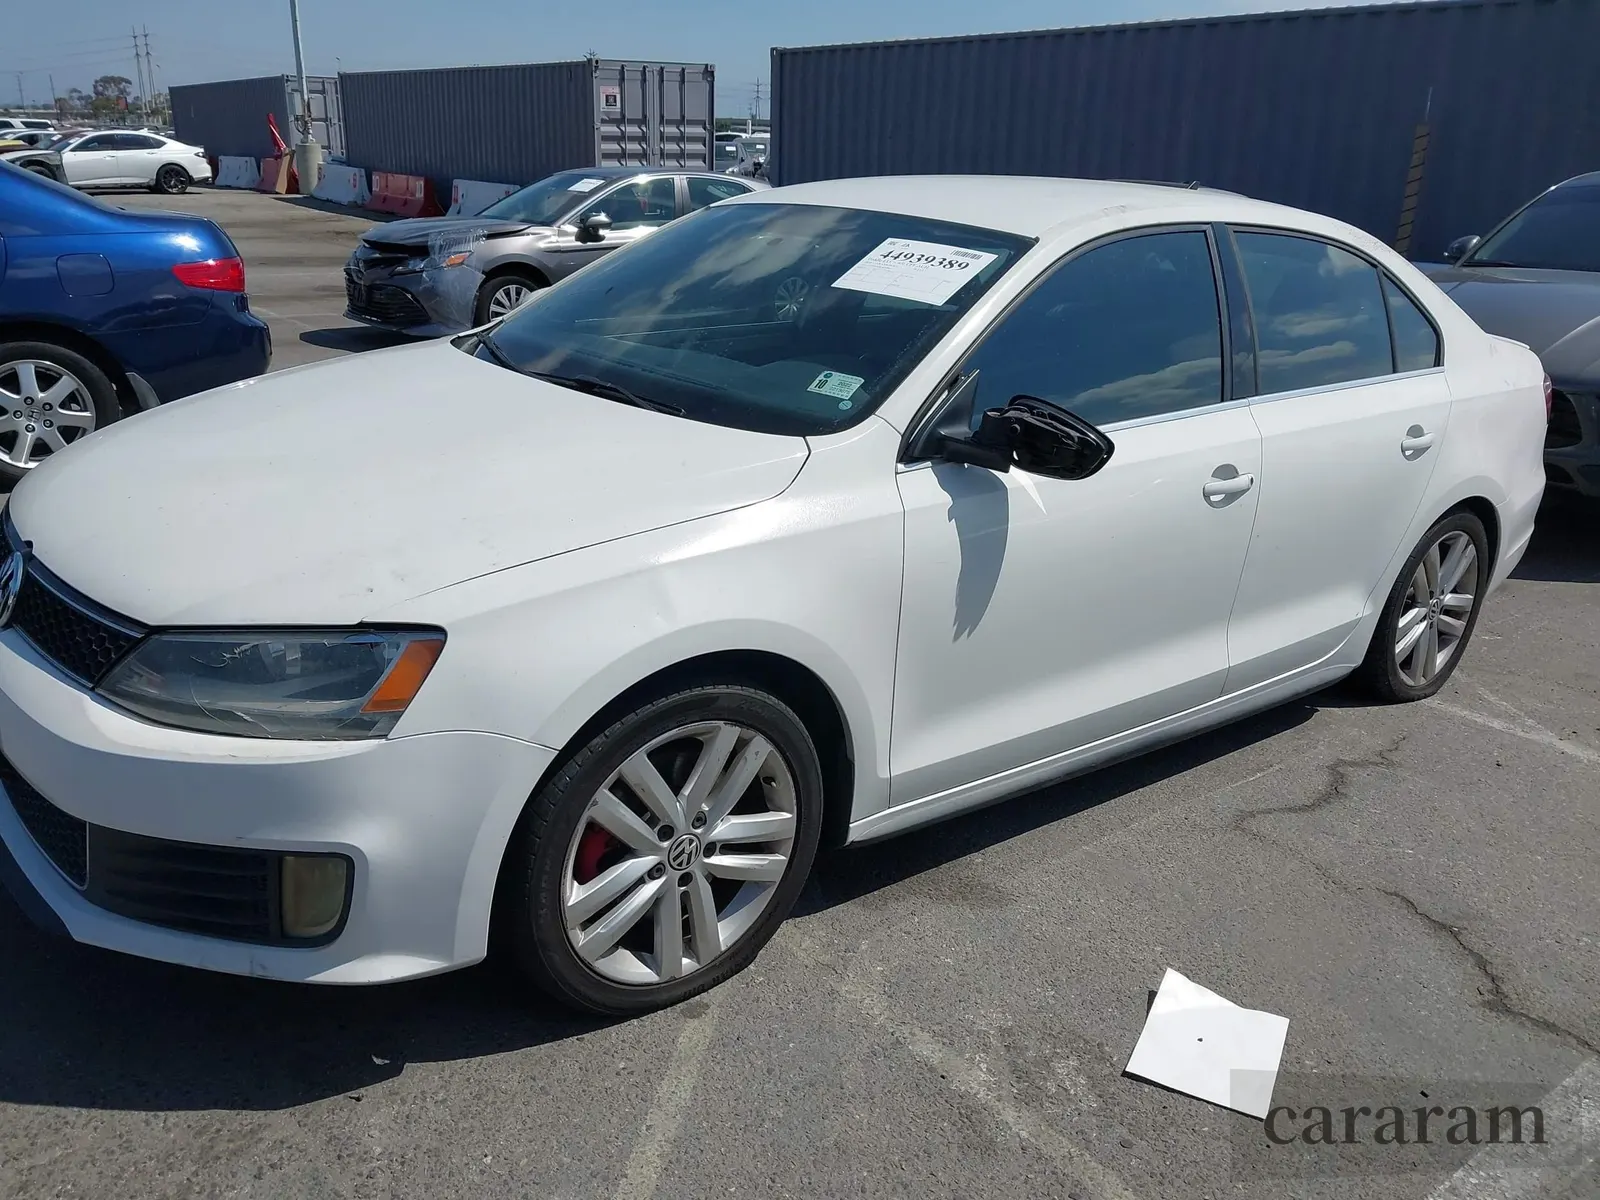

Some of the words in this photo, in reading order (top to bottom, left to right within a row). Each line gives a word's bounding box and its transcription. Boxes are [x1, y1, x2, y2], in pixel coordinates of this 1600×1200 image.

[415, 180, 424, 198] 10
[880, 250, 970, 272] 44939389
[814, 379, 829, 389] 10
